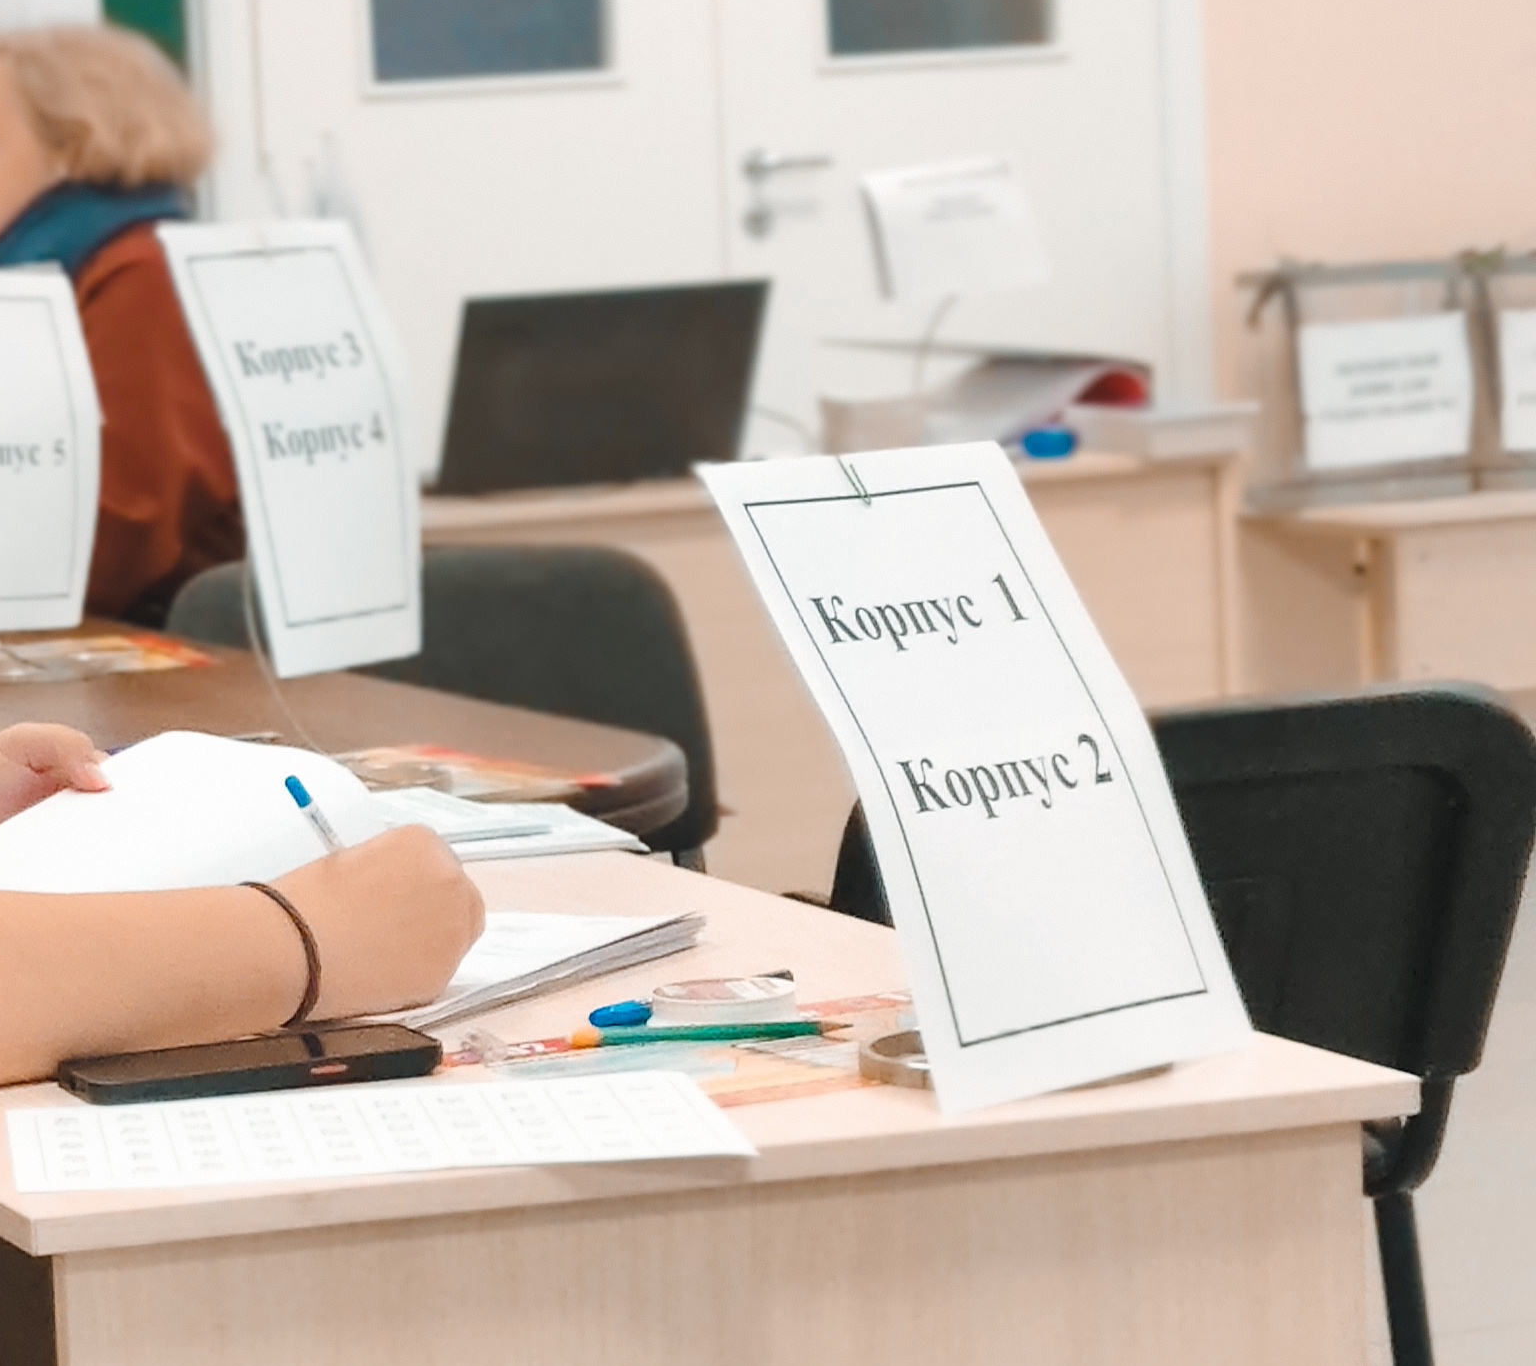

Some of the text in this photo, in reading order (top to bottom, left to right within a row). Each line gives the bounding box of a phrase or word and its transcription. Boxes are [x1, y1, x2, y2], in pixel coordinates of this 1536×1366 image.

[234, 330, 363, 383] Корпус 3
[53, 437, 67, 467] 5
[262, 411, 385, 465] Корпус 4
[809, 573, 1029, 651] Корпус 1
[897, 733, 1114, 820] Корпус 2
